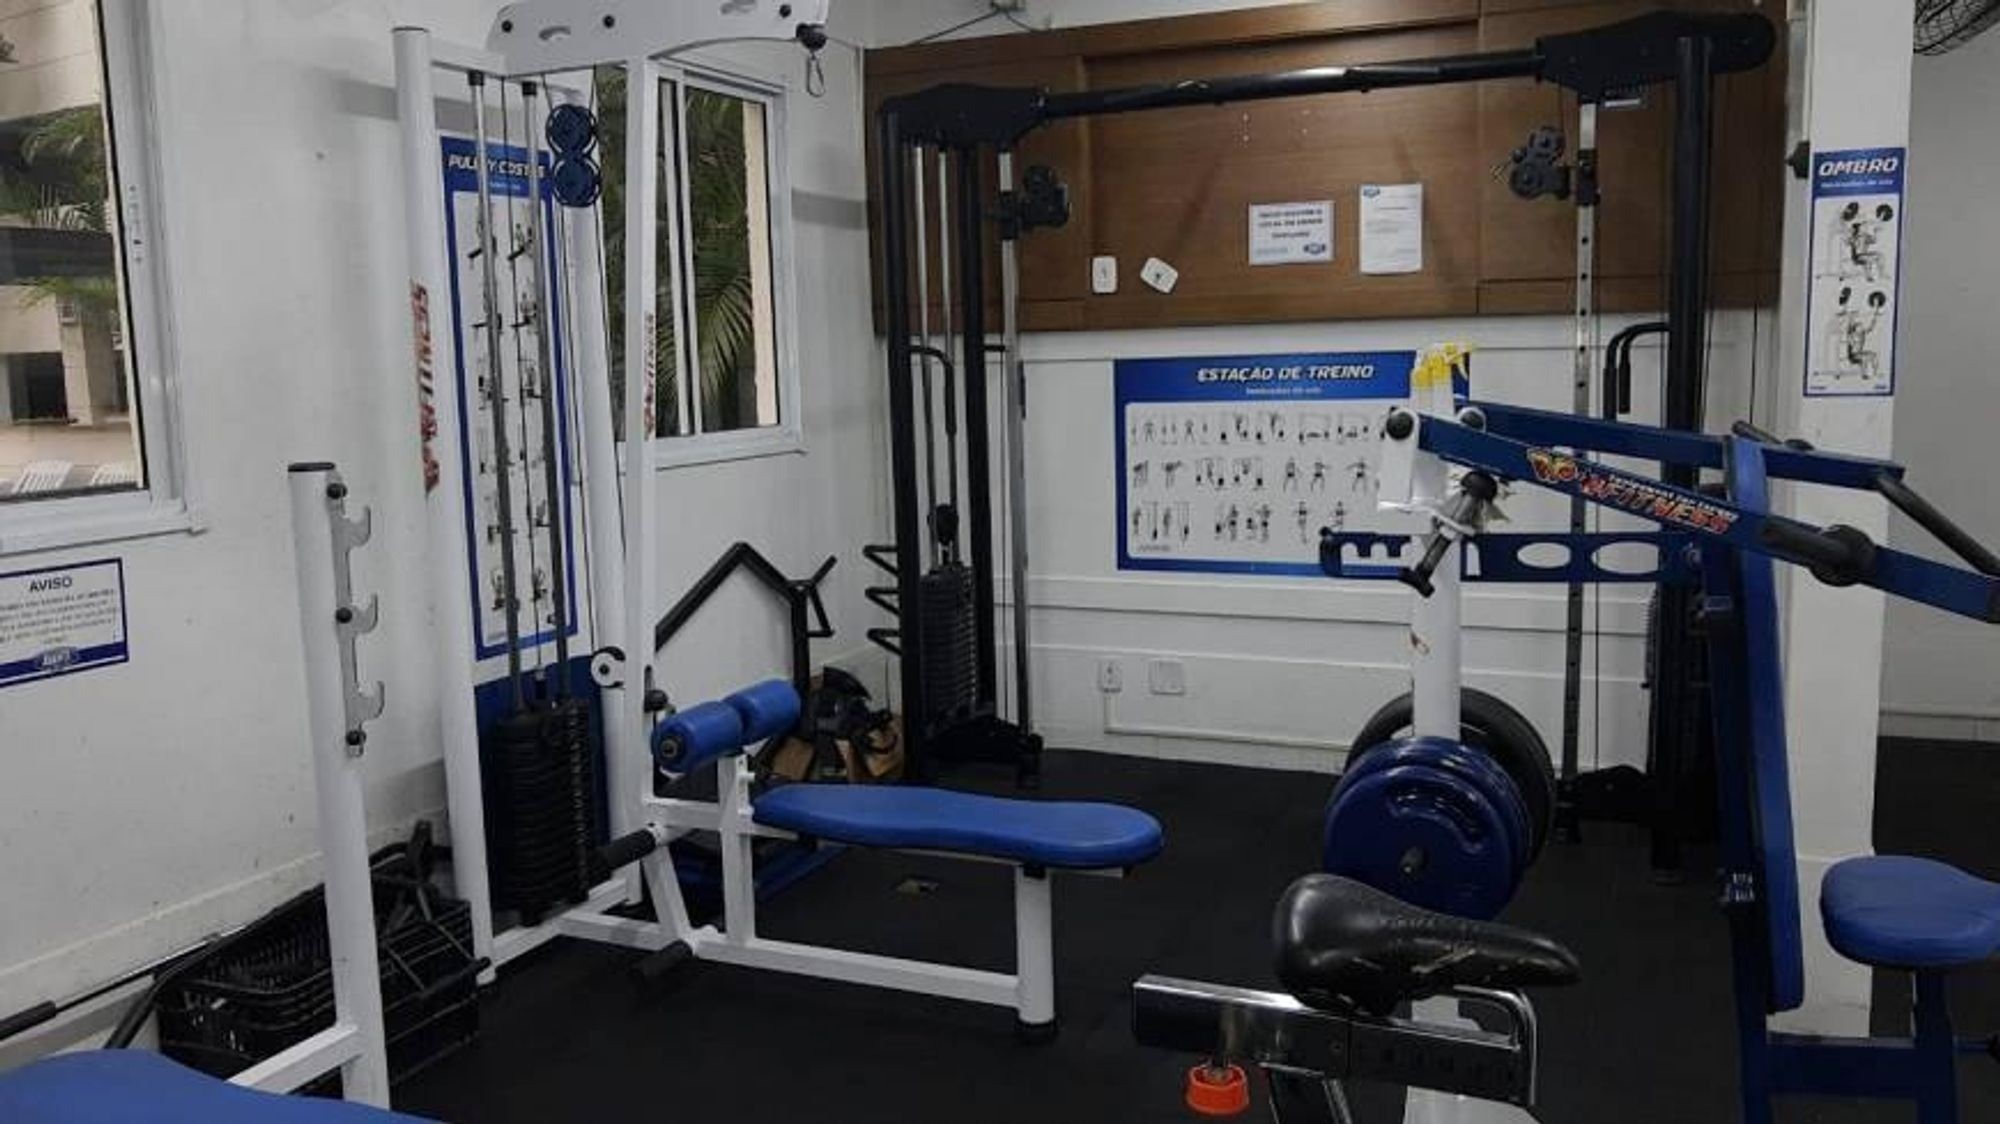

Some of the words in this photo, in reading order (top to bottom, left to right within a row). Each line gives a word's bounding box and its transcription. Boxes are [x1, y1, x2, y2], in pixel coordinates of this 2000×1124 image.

[1820, 157, 1898, 176] OMBRO
[1196, 366, 1275, 383] ESTAÇÃO
[1277, 366, 1303, 381] DE
[1307, 364, 1375, 380] TREINO
[30, 576, 72, 592] AVISO
